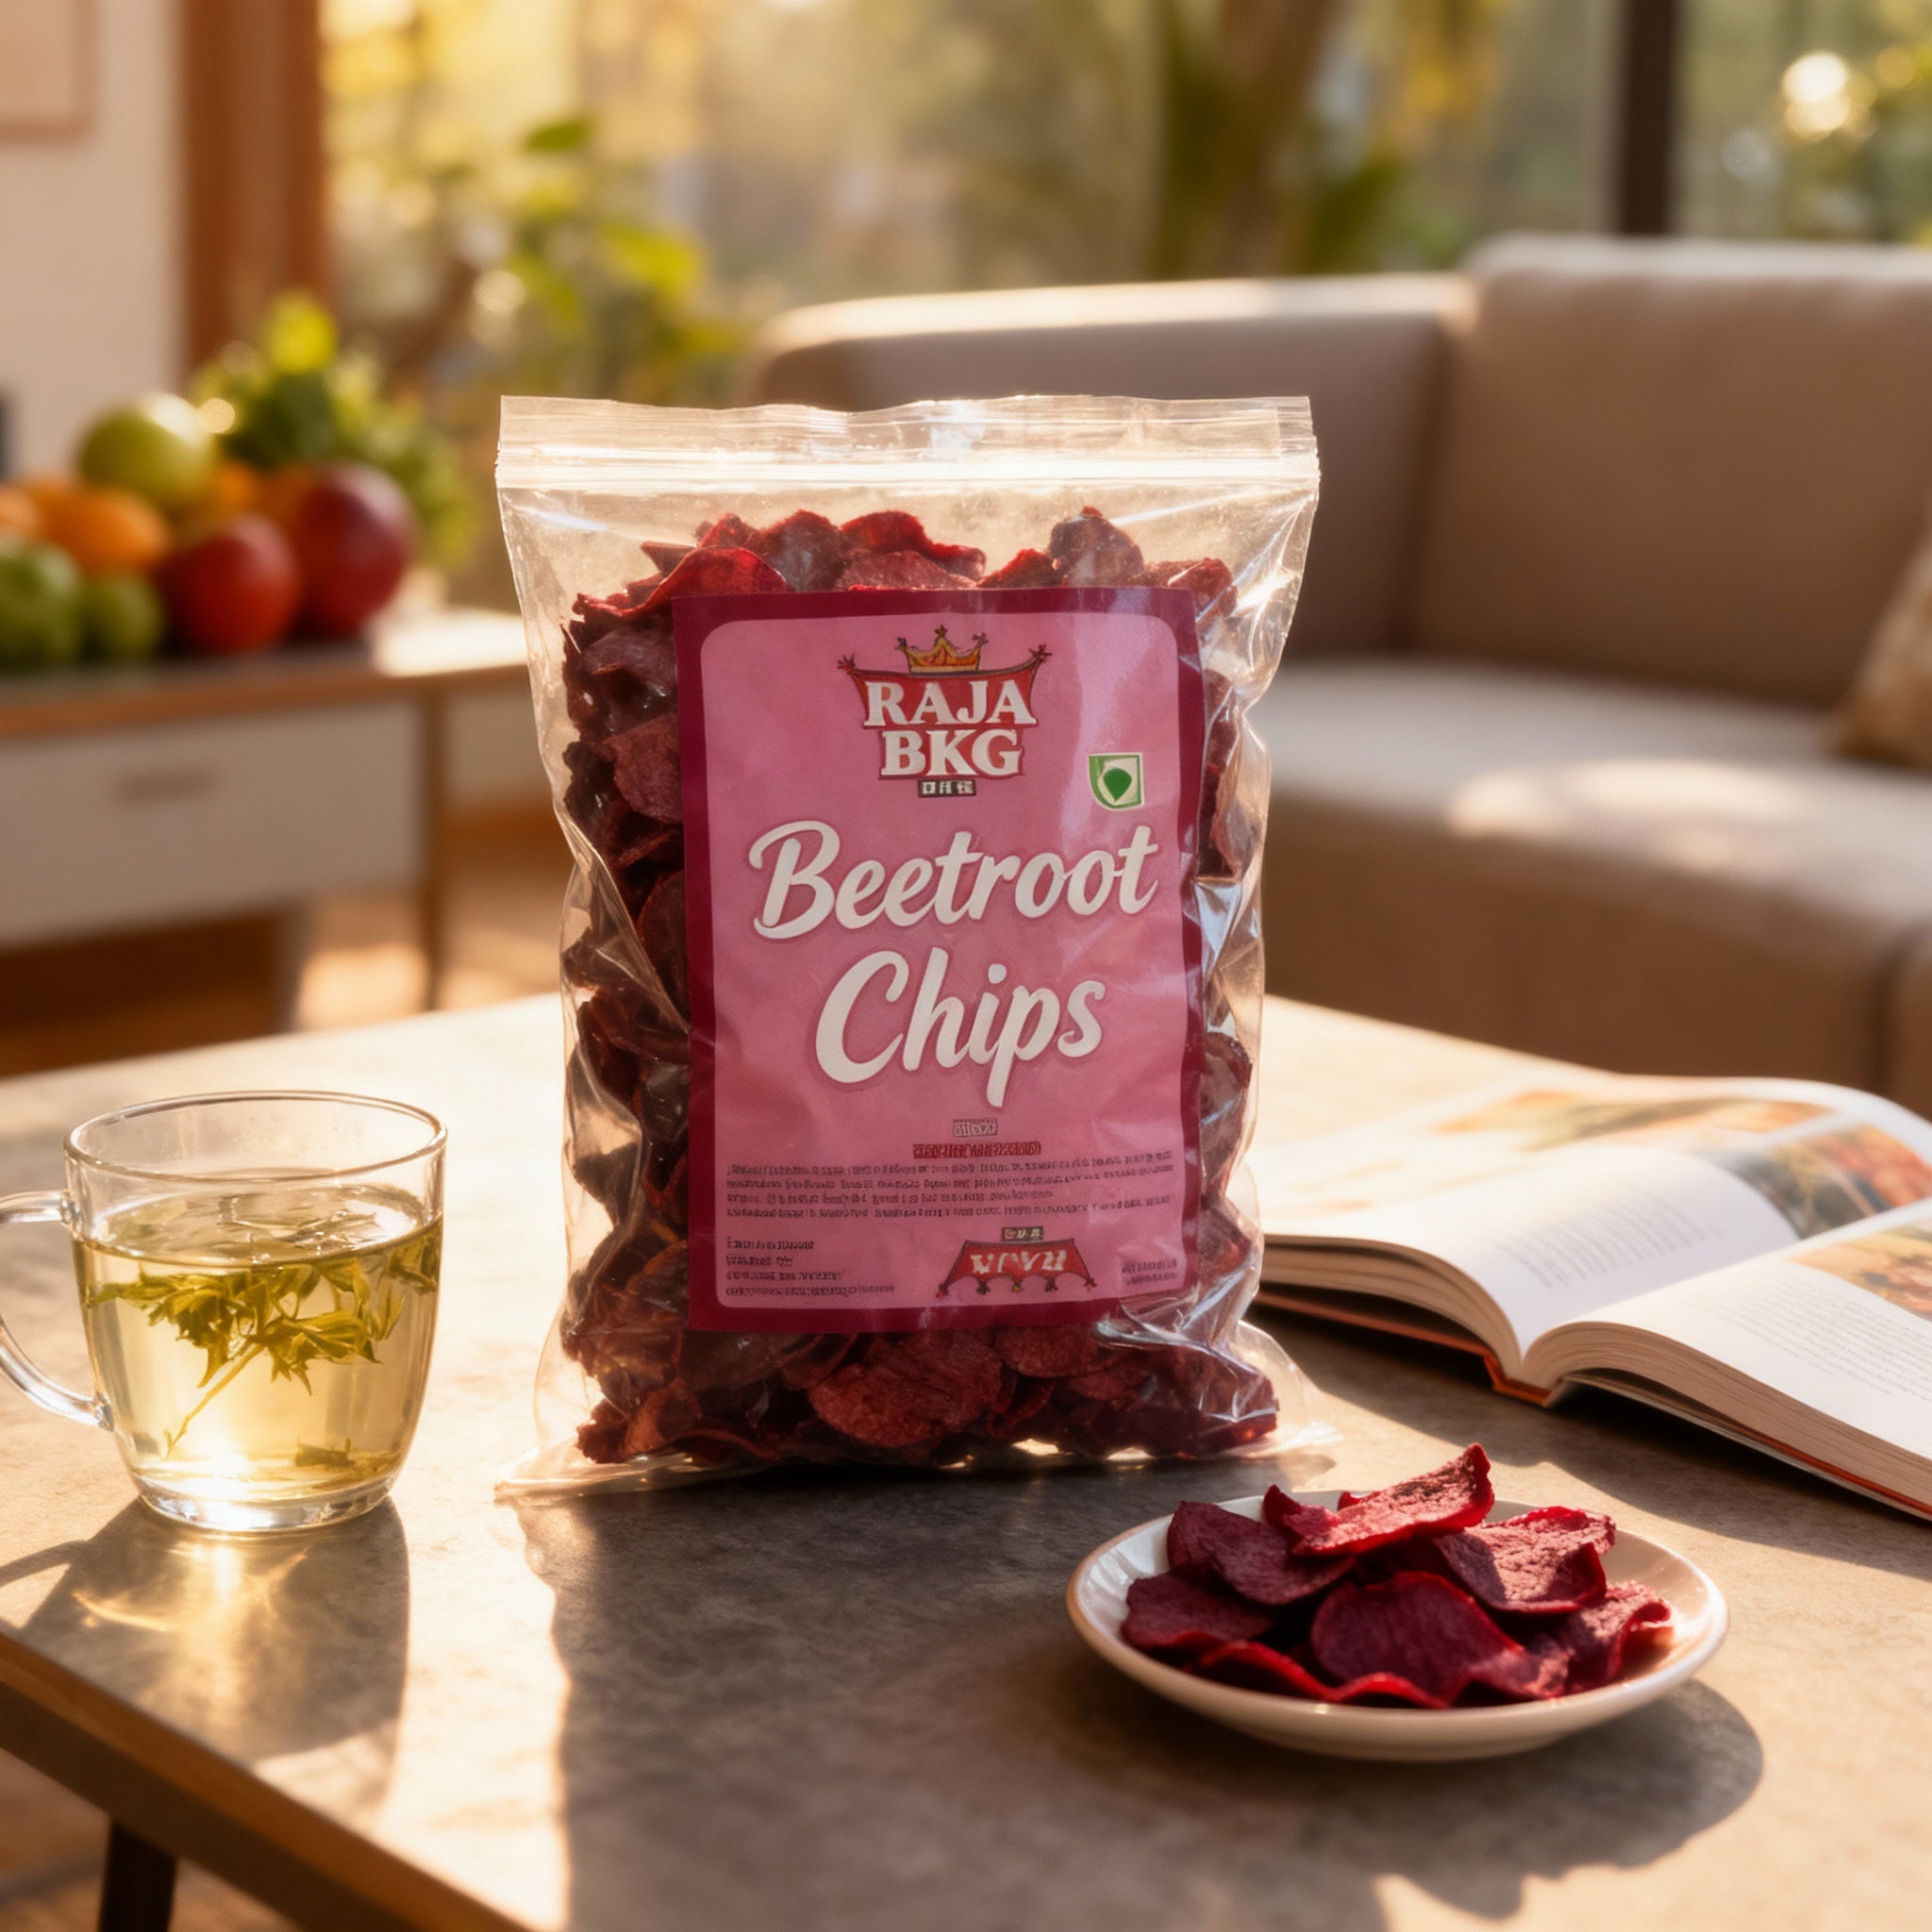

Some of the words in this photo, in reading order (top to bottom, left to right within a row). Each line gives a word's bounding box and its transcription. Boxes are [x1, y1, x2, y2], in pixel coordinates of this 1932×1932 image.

[863, 679, 1037, 726] RAJA
[880, 729, 1023, 776] BKG
[749, 820, 1158, 940] Beetroot
[815, 947, 1106, 1108] Chips
